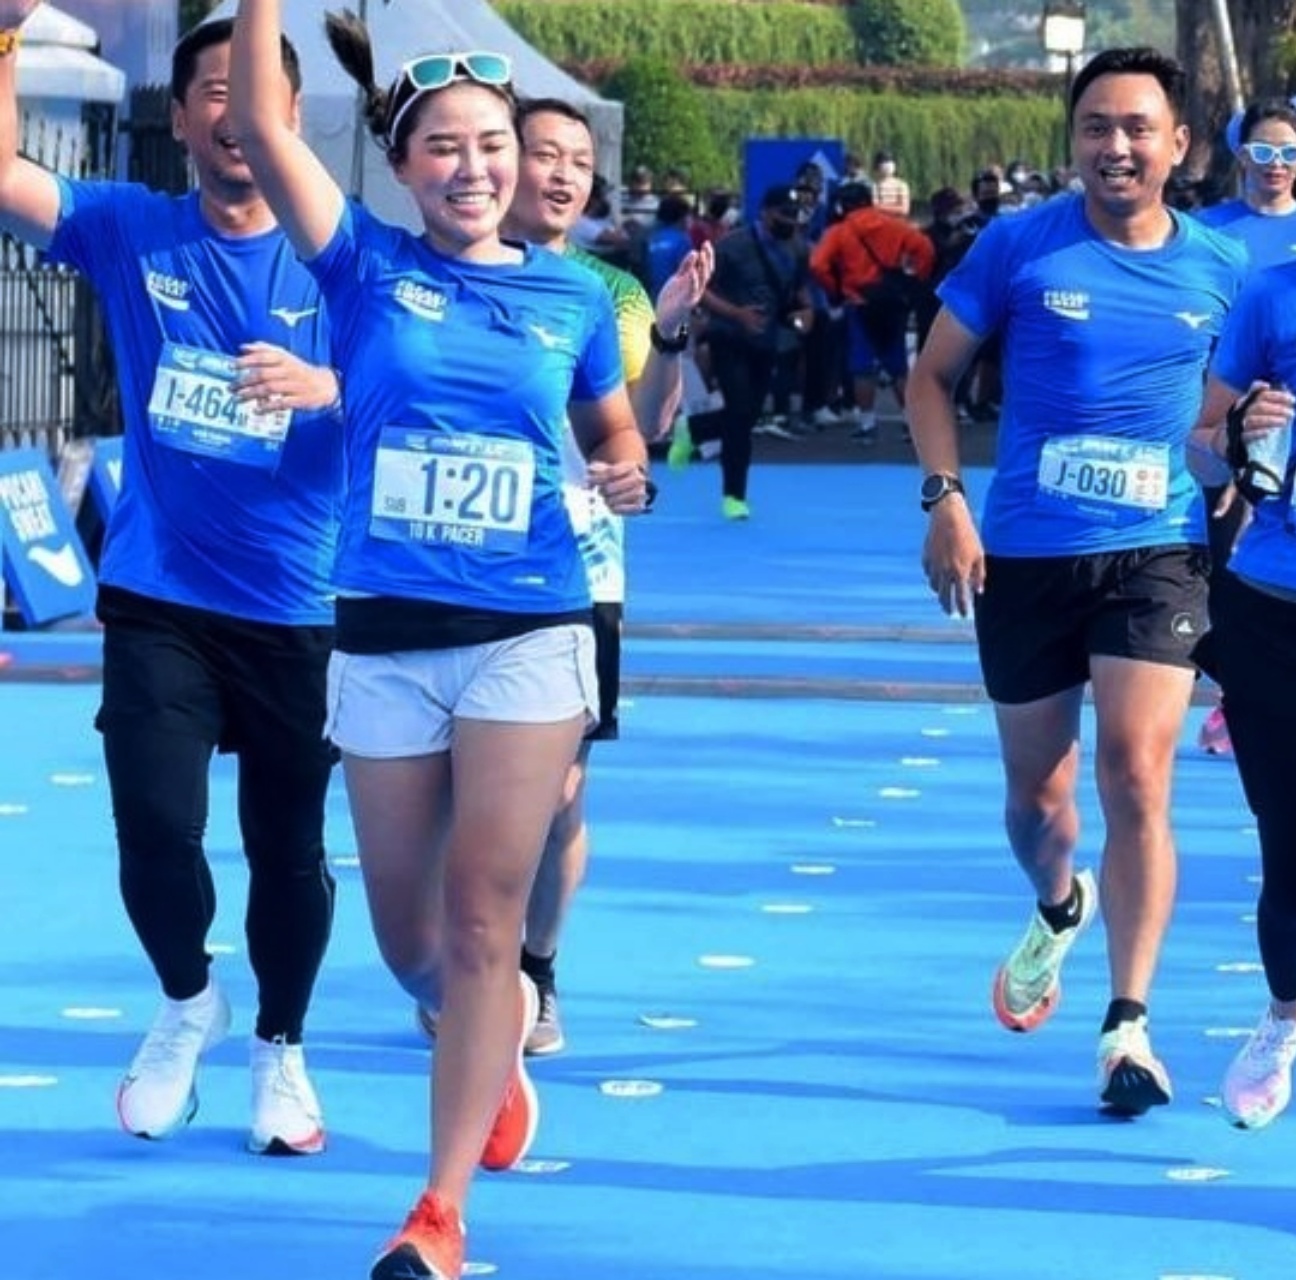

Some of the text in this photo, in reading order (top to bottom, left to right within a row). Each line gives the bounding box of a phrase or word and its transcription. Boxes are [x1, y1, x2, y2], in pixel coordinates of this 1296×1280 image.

[420, 457, 520, 524] 1:20
[1056, 460, 1127, 498] J-030
[442, 525, 484, 546] PACER
